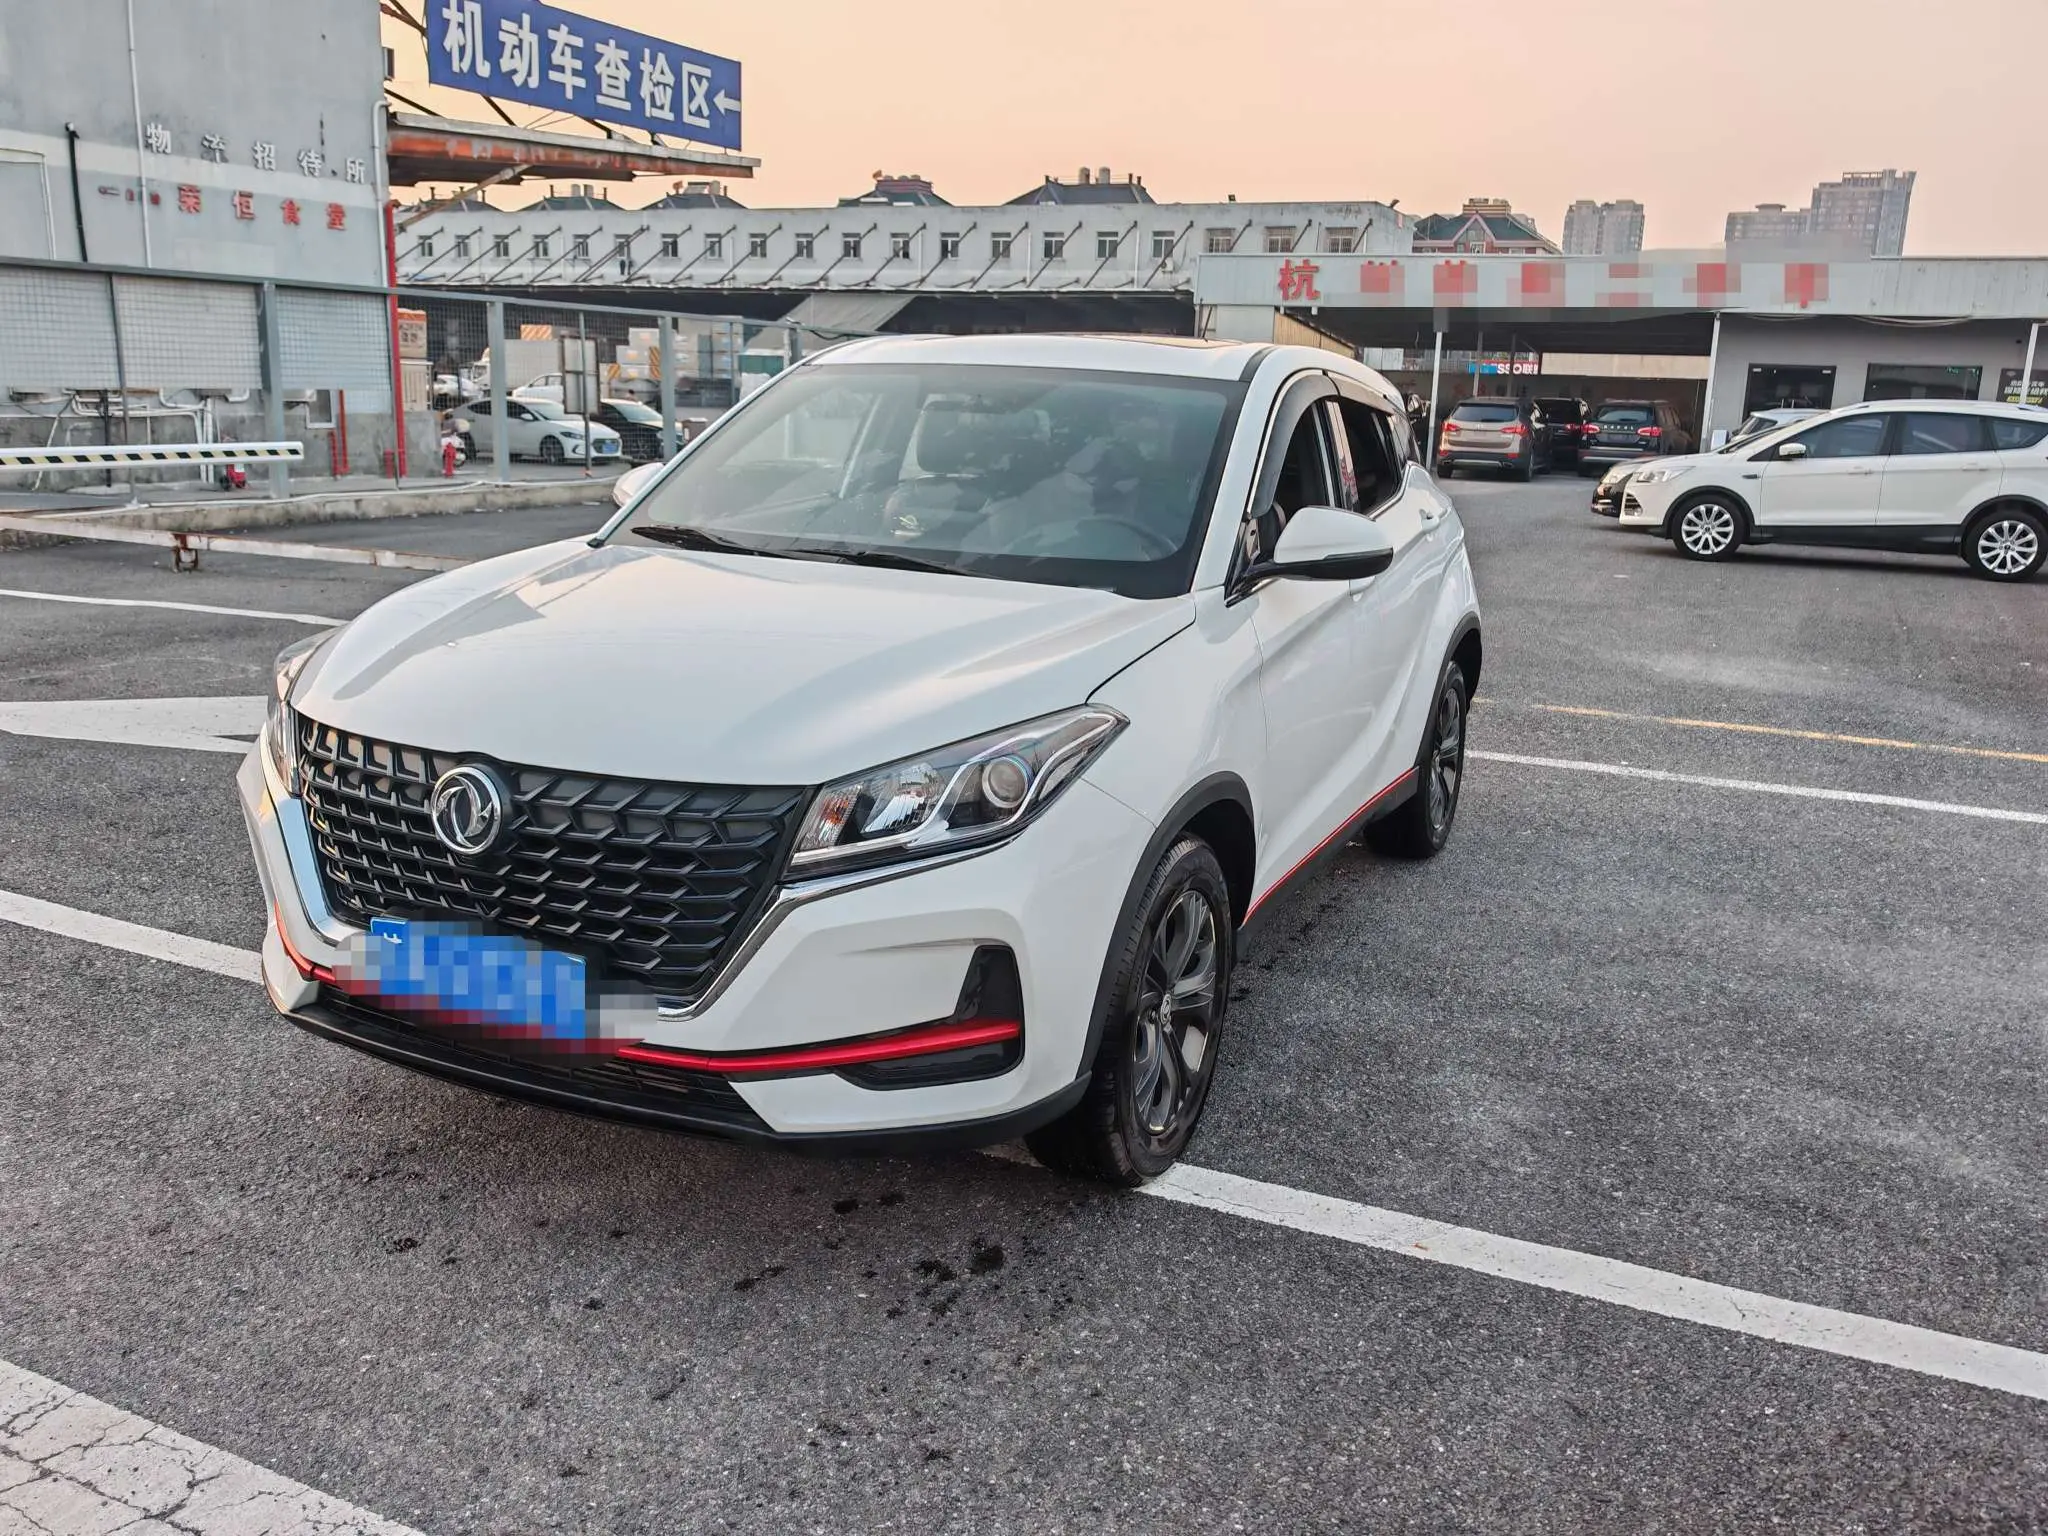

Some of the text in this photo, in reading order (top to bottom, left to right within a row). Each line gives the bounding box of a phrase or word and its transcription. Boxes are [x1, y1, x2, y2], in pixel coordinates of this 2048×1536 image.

[442, 0, 711, 129] 机动车查检区
